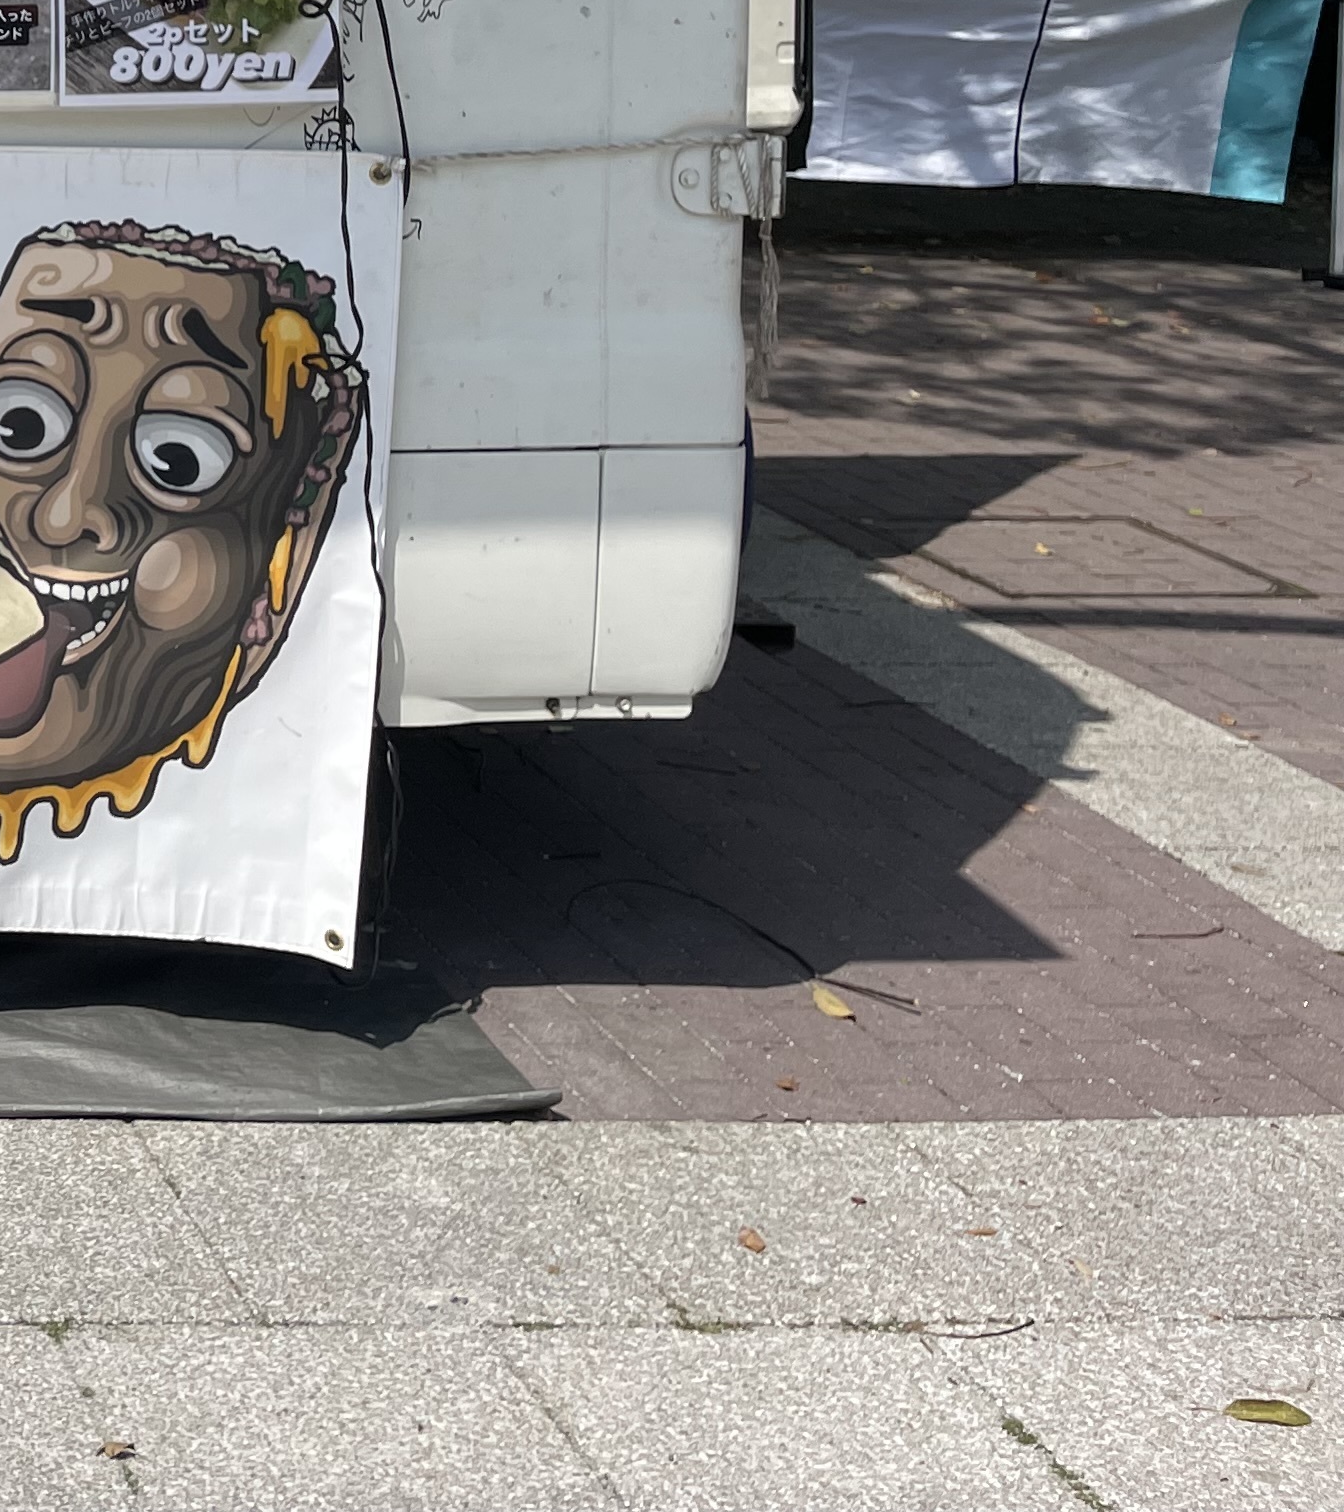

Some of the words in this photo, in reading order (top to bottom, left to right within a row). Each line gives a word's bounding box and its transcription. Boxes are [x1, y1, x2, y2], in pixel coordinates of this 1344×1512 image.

[145, 17, 263, 48] 2pセット
[109, 45, 296, 92] 800yen
